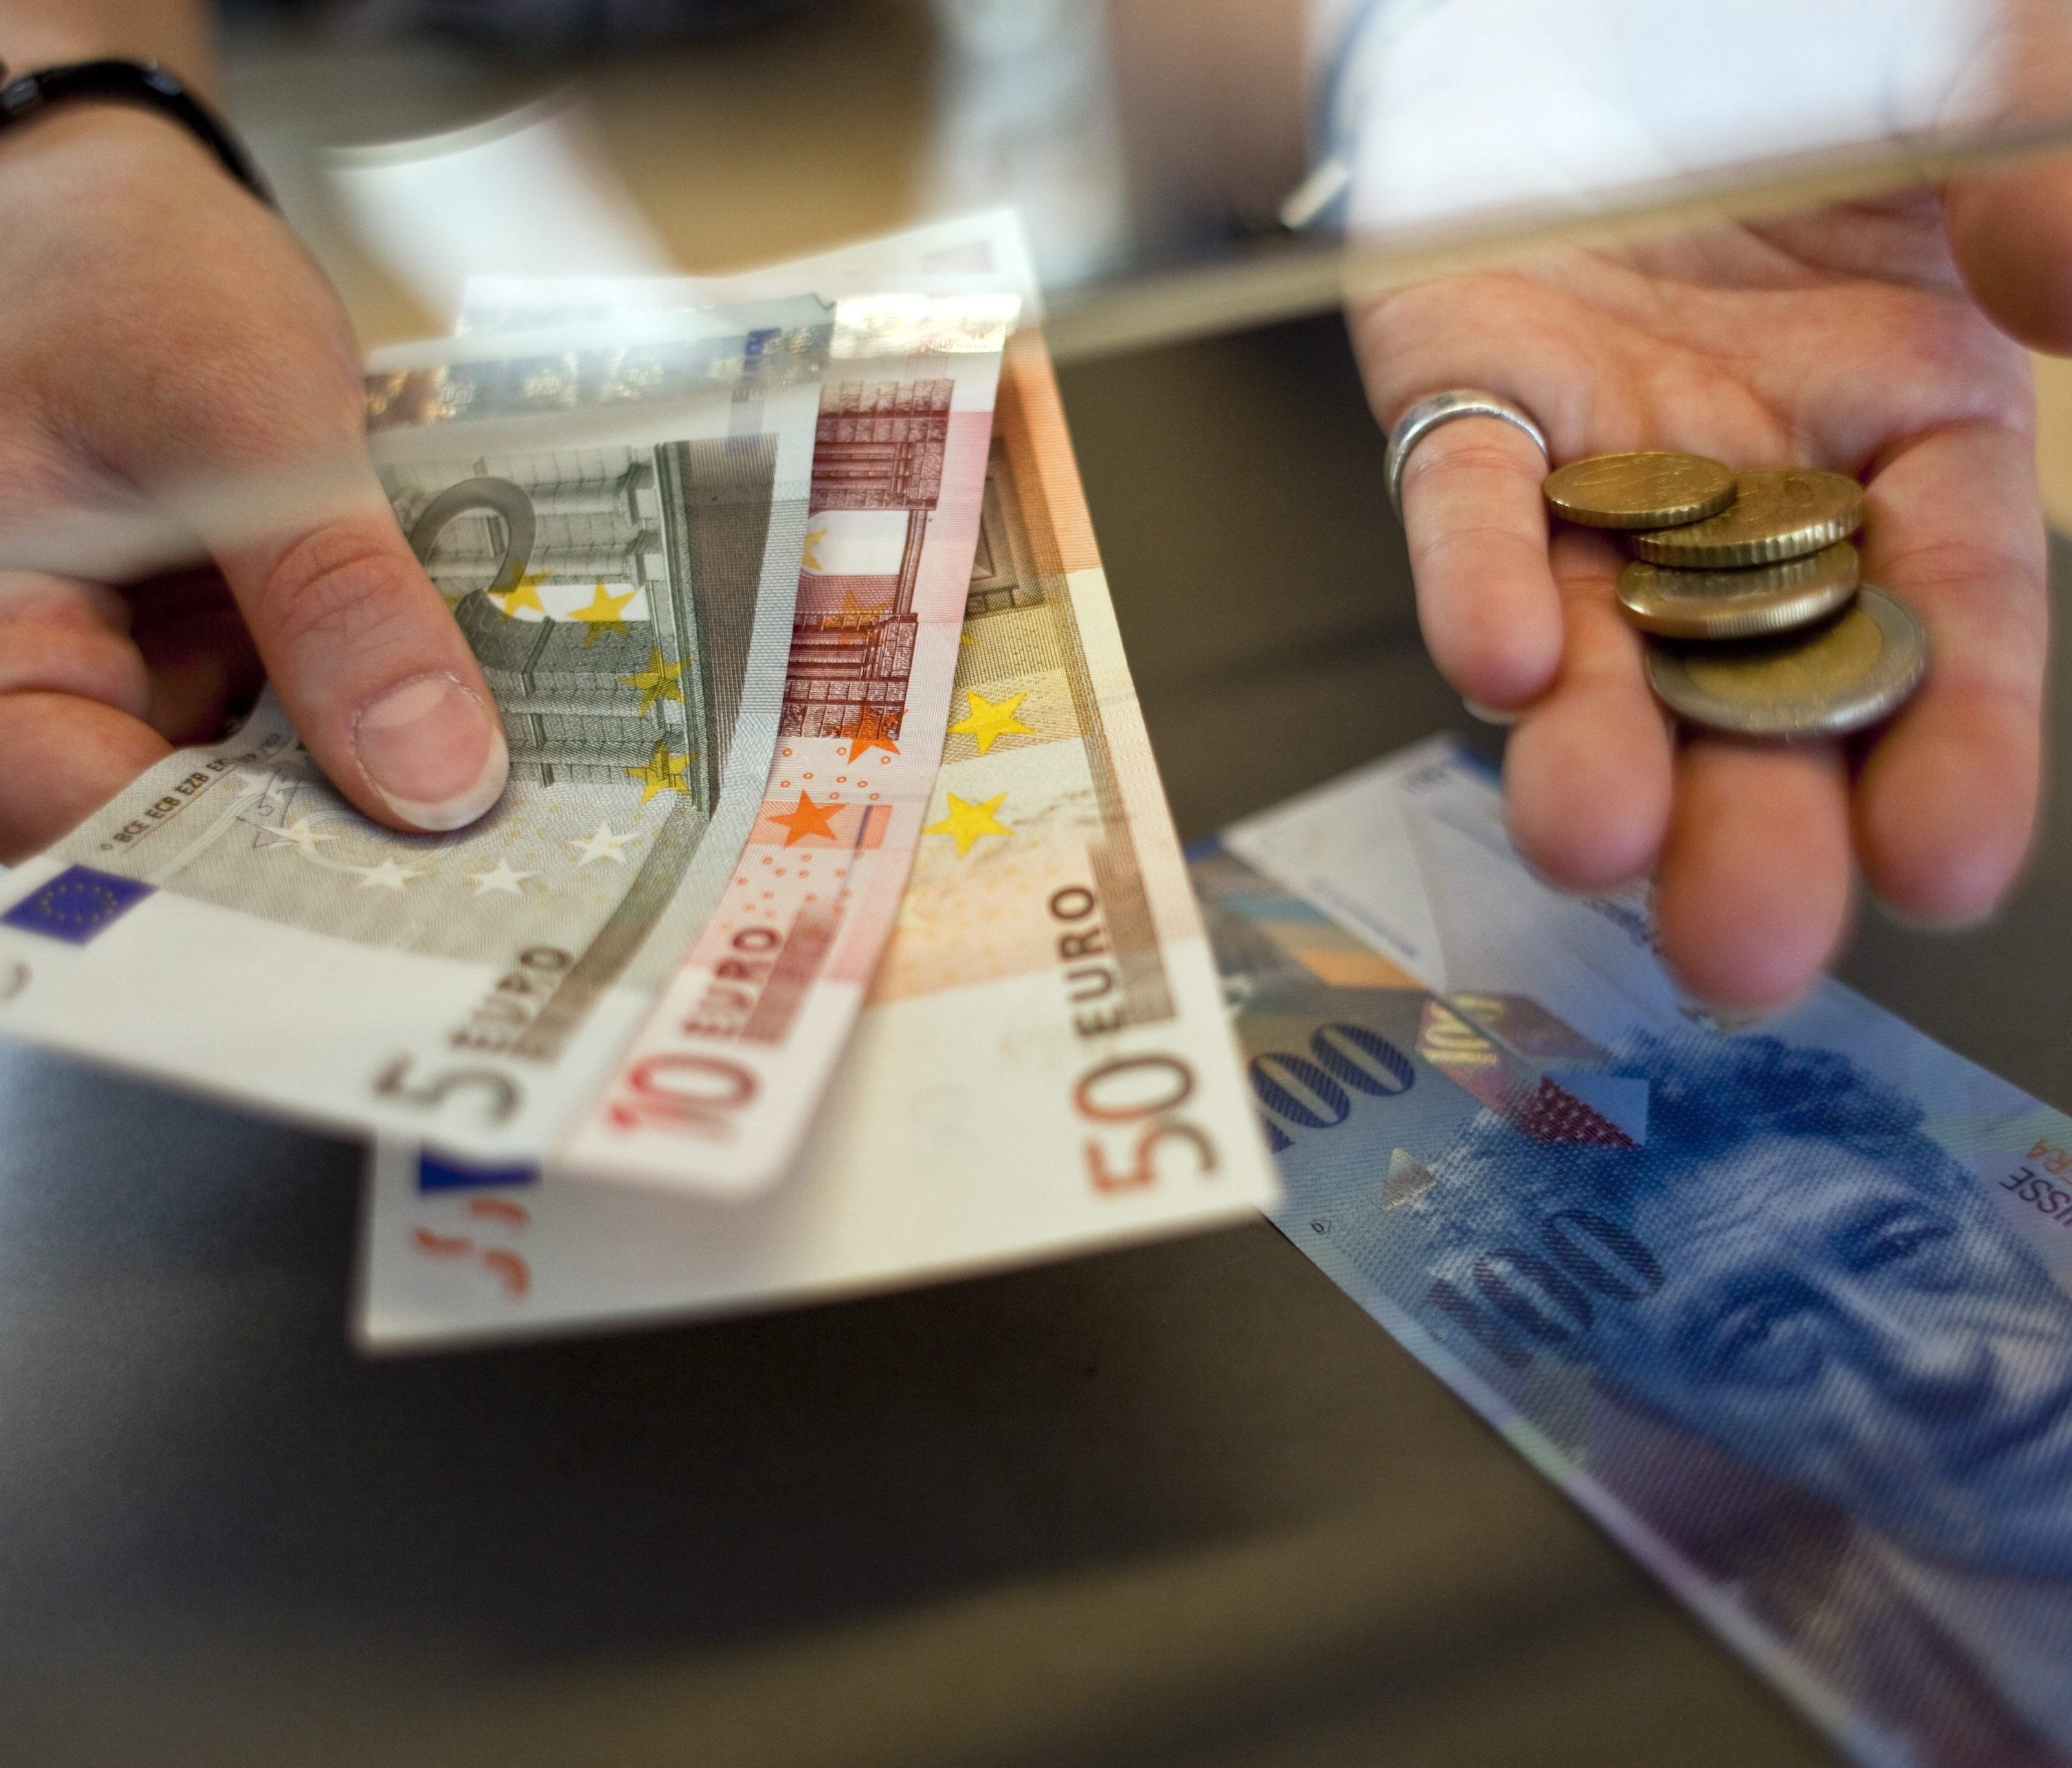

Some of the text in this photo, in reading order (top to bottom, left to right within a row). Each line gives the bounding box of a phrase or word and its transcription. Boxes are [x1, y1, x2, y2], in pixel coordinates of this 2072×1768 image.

[113, 819, 150, 844] BCE
[144, 796, 181, 820] ECB
[174, 772, 210, 796] EZB
[372, 1053, 523, 1130] 5
[448, 945, 574, 1059] EURO
[609, 926, 784, 1143] 10 EURO
[1047, 884, 1220, 1198] 50 EURO
[1999, 1166, 2072, 1227] ISSE
[1424, 1208, 1665, 1369] 100
